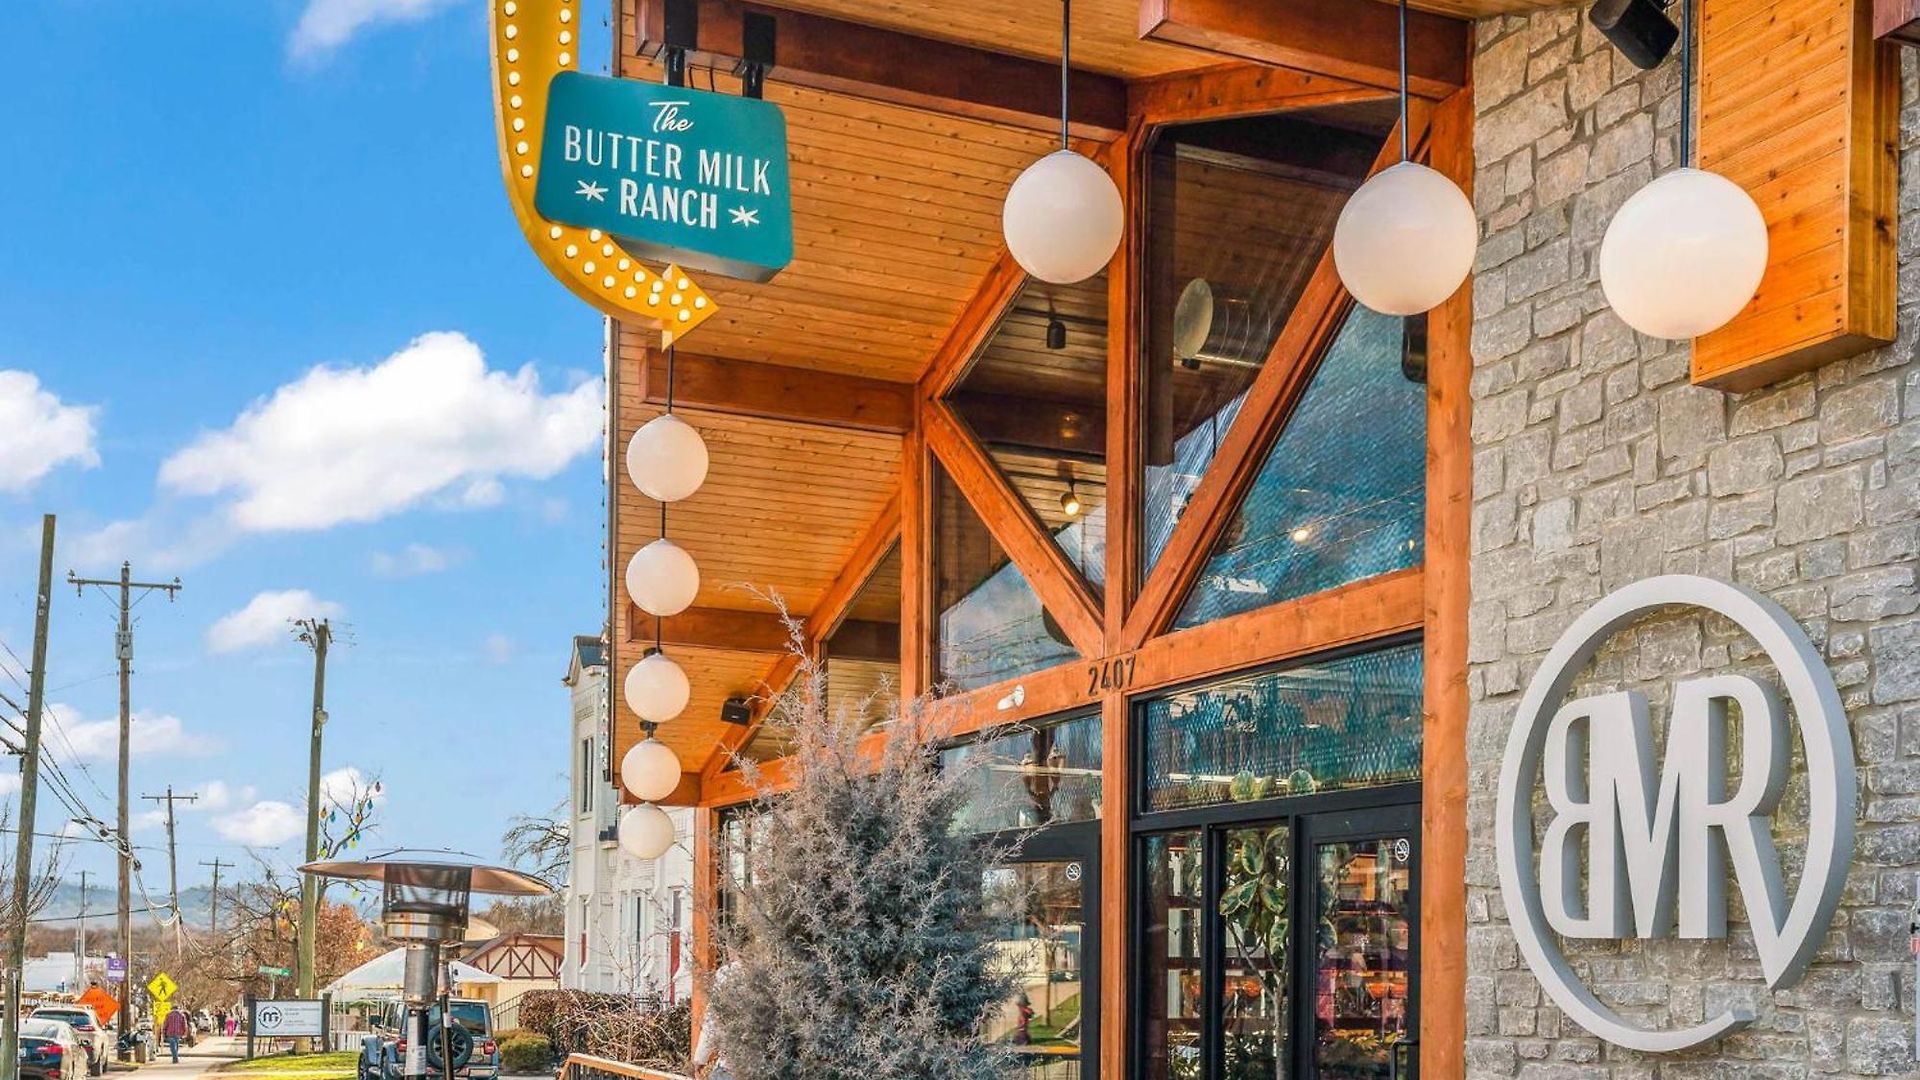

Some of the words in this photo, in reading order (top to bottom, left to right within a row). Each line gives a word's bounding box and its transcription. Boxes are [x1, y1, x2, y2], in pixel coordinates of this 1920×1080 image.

[648, 101, 694, 133] The
[565, 125, 682, 180] BUTTER
[699, 149, 771, 195] MILK
[620, 178, 718, 229] RANCH
[1088, 654, 1136, 696] 2407
[1538, 672, 1794, 992] BMR
